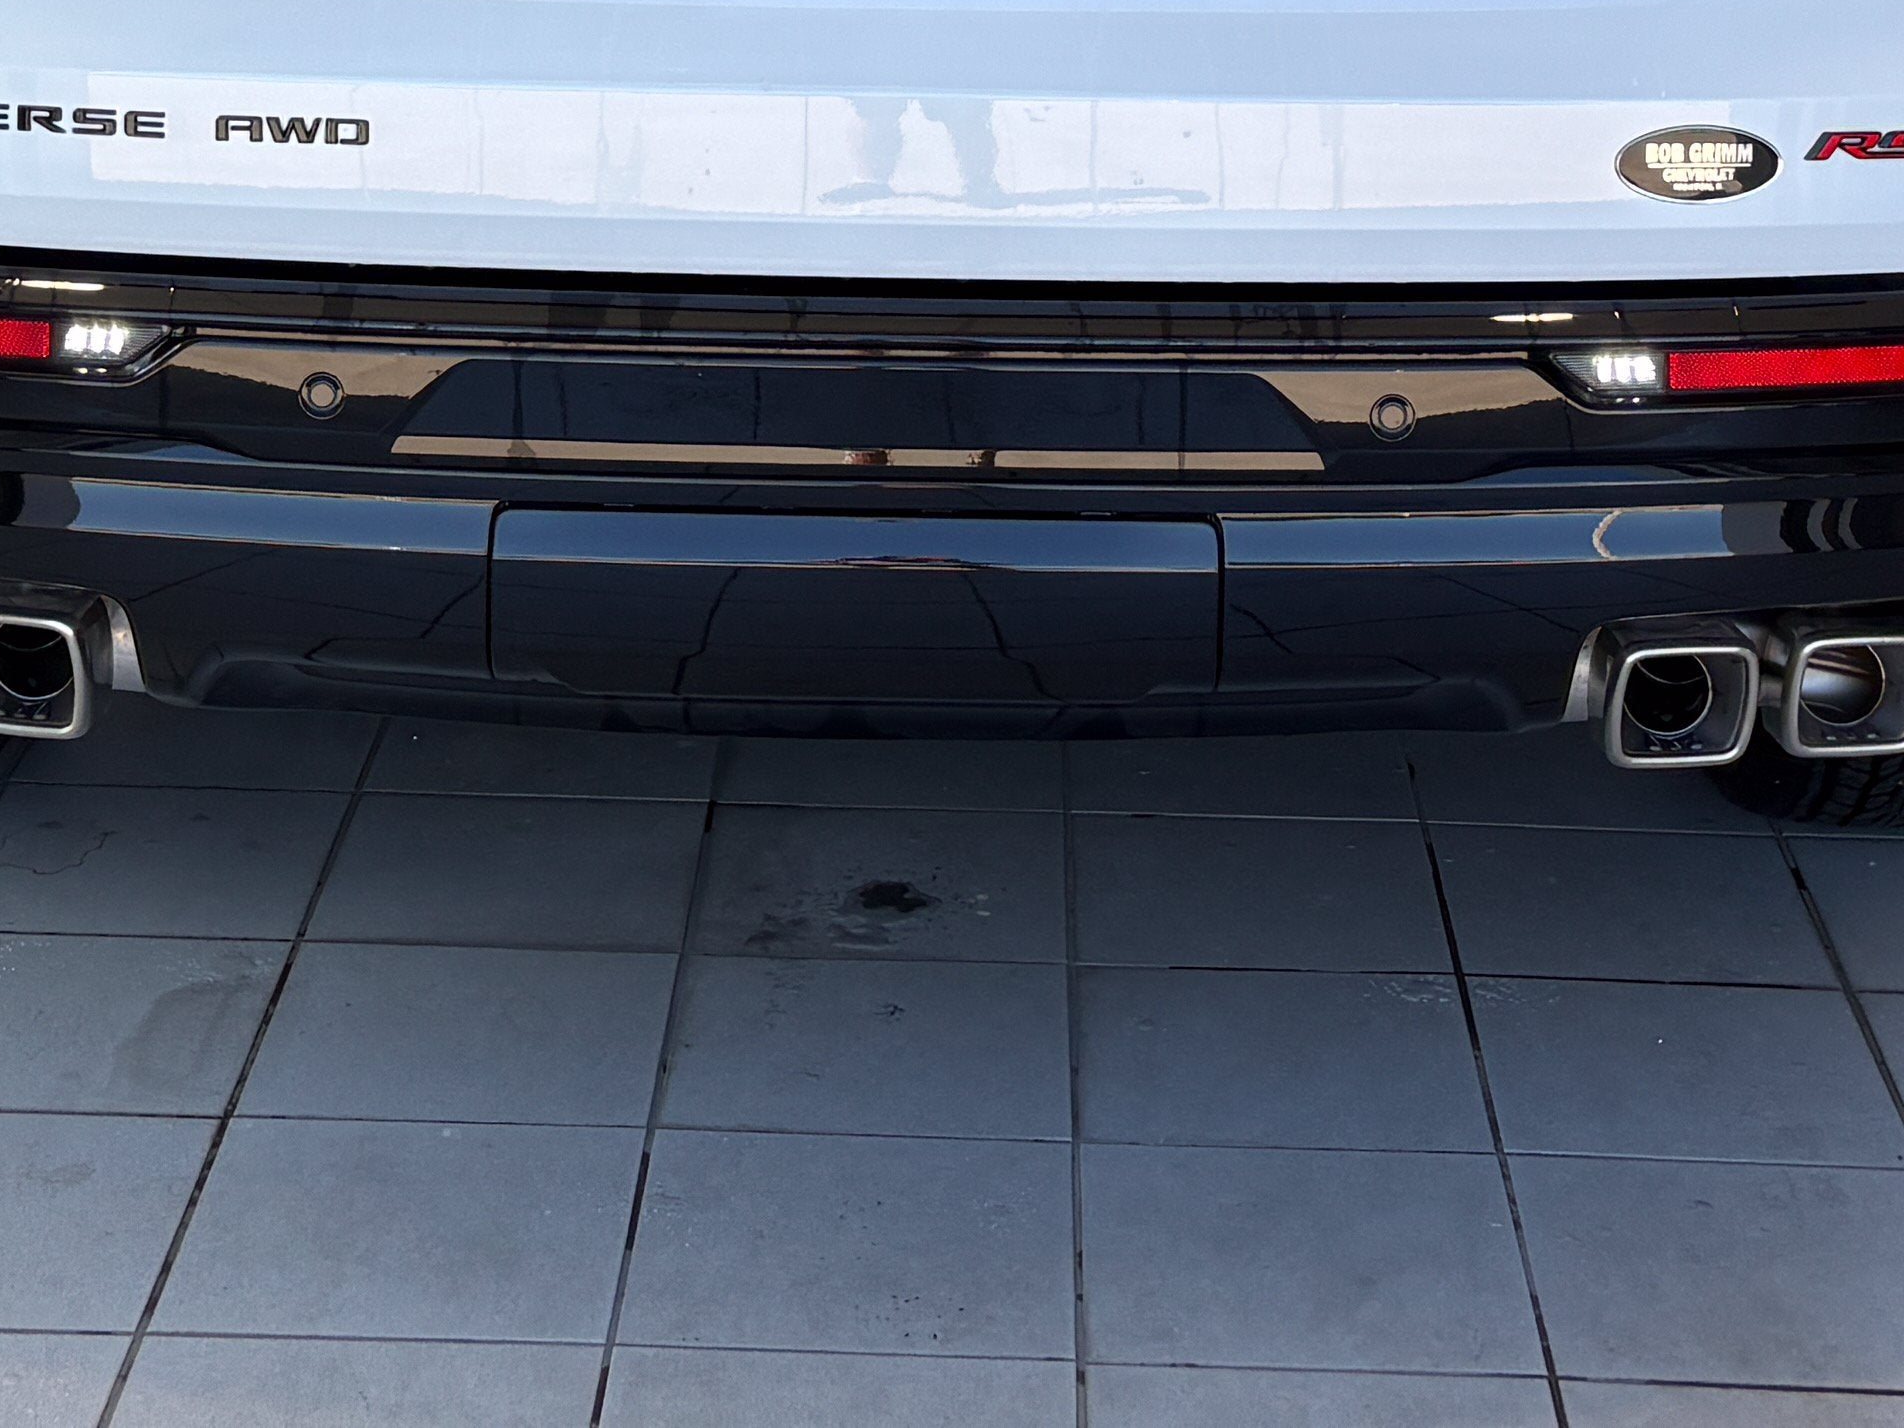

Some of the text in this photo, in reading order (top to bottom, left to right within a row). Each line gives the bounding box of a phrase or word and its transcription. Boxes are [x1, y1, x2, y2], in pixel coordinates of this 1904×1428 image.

[214, 113, 371, 146] AWD
[1644, 142, 1754, 164] BOB GRIMM
